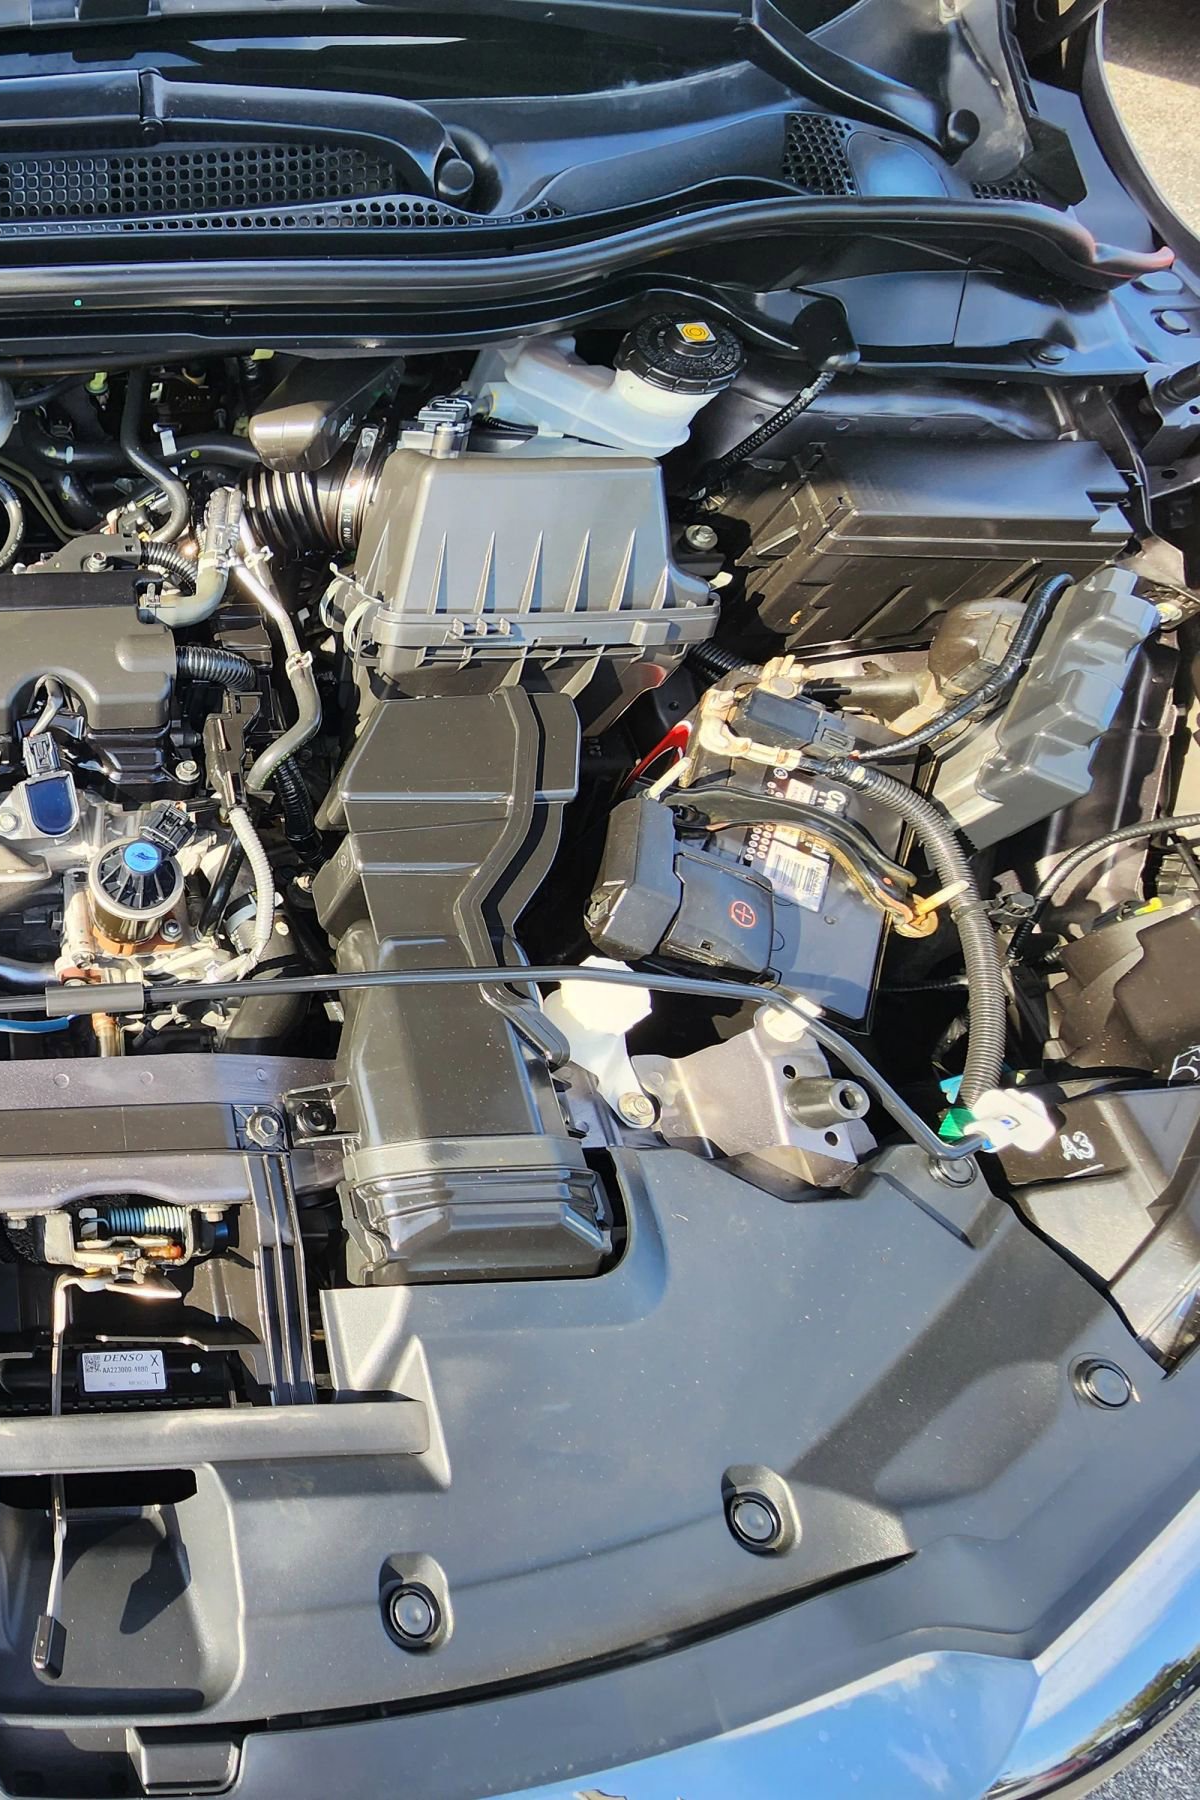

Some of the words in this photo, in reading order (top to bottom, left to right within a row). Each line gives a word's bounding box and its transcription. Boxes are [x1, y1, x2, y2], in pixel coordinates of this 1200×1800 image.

[1060, 1131, 1096, 1160] A3
[103, 1353, 144, 1362] DENSO
[150, 1354, 159, 1367] X
[151, 1372, 160, 1385] T
